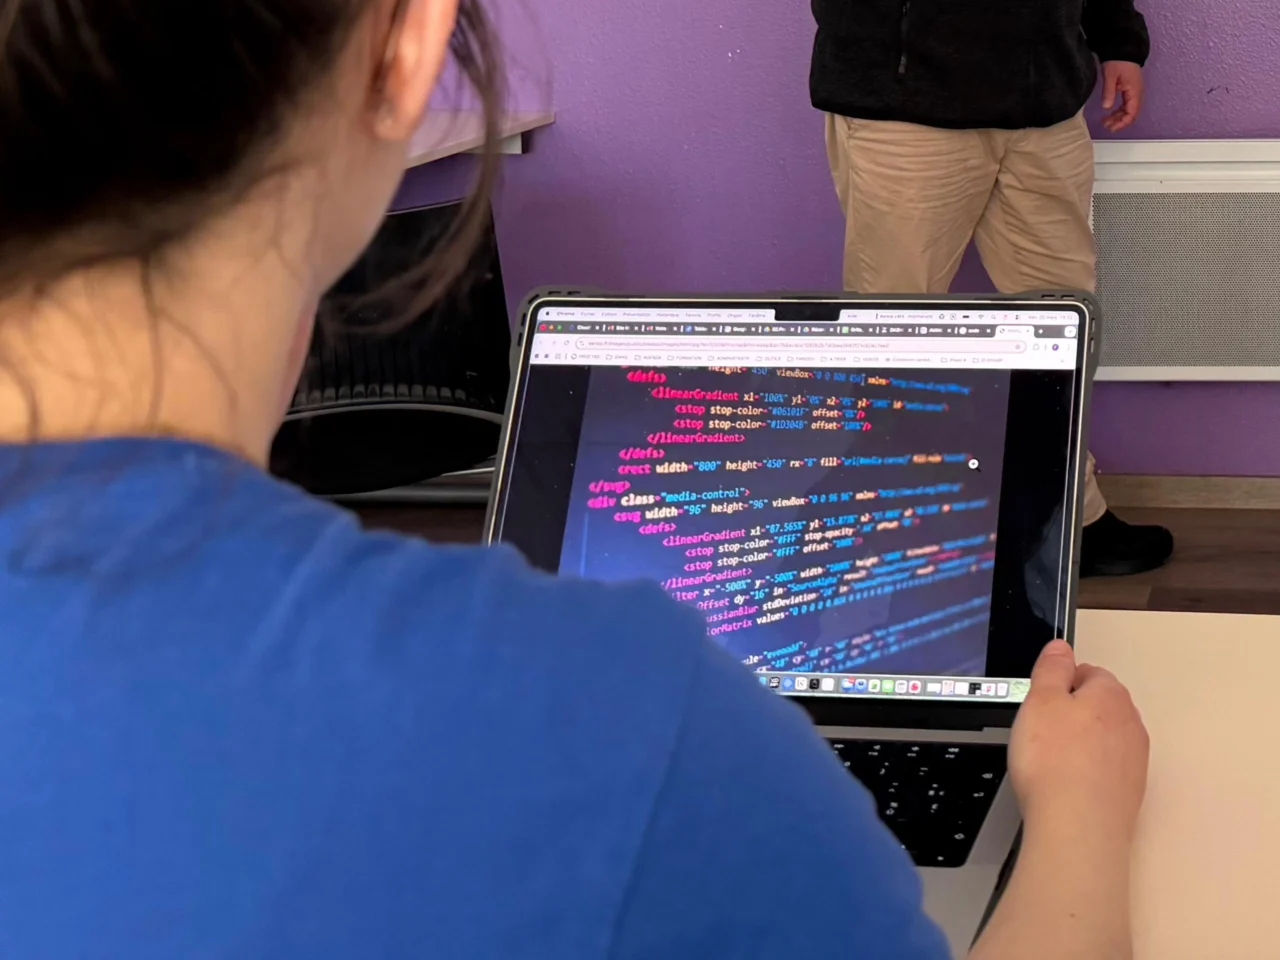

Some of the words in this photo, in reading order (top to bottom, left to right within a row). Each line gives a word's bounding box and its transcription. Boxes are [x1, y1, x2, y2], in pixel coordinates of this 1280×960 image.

[652, 385, 739, 400] <linearGradient
[675, 404, 706, 415] <stop
[673, 418, 704, 430] <stop
[647, 431, 746, 444] </linearGradient>
[638, 523, 677, 535] <defs>
[685, 546, 714, 557] <stop
[684, 561, 713, 572] <stop
